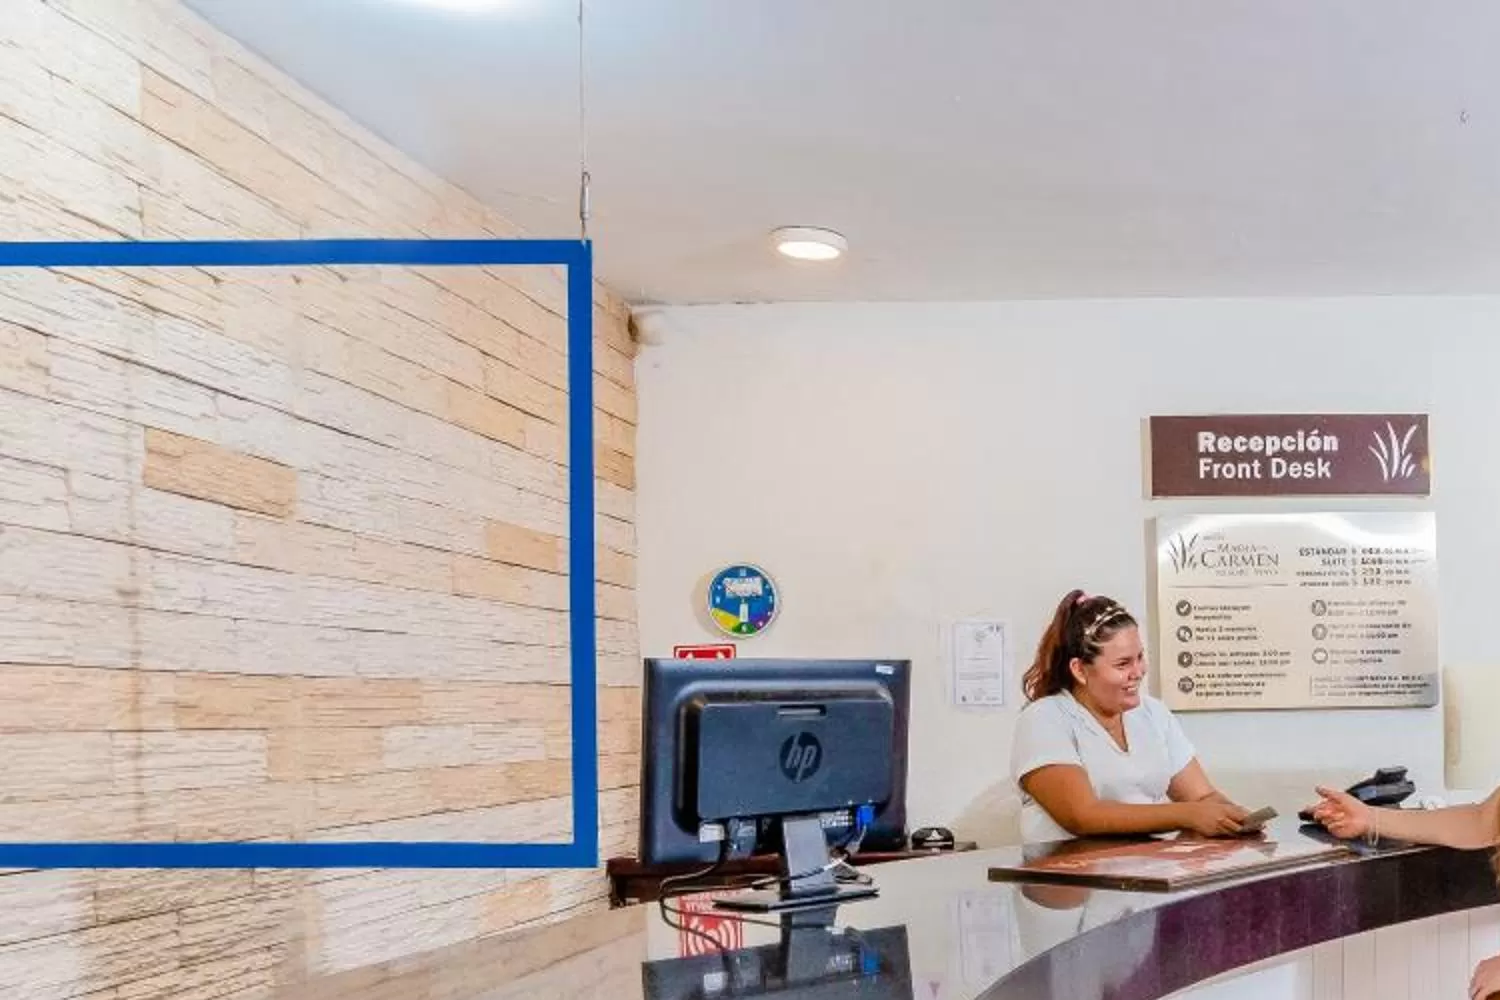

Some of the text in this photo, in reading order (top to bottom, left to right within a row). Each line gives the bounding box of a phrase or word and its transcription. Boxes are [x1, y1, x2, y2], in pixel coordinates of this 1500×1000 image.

[1198, 429, 1339, 456] Recepción
[1199, 457, 1331, 479] Front Desk
[1201, 549, 1280, 568] CARMEN
[783, 732, 819, 783] hp
